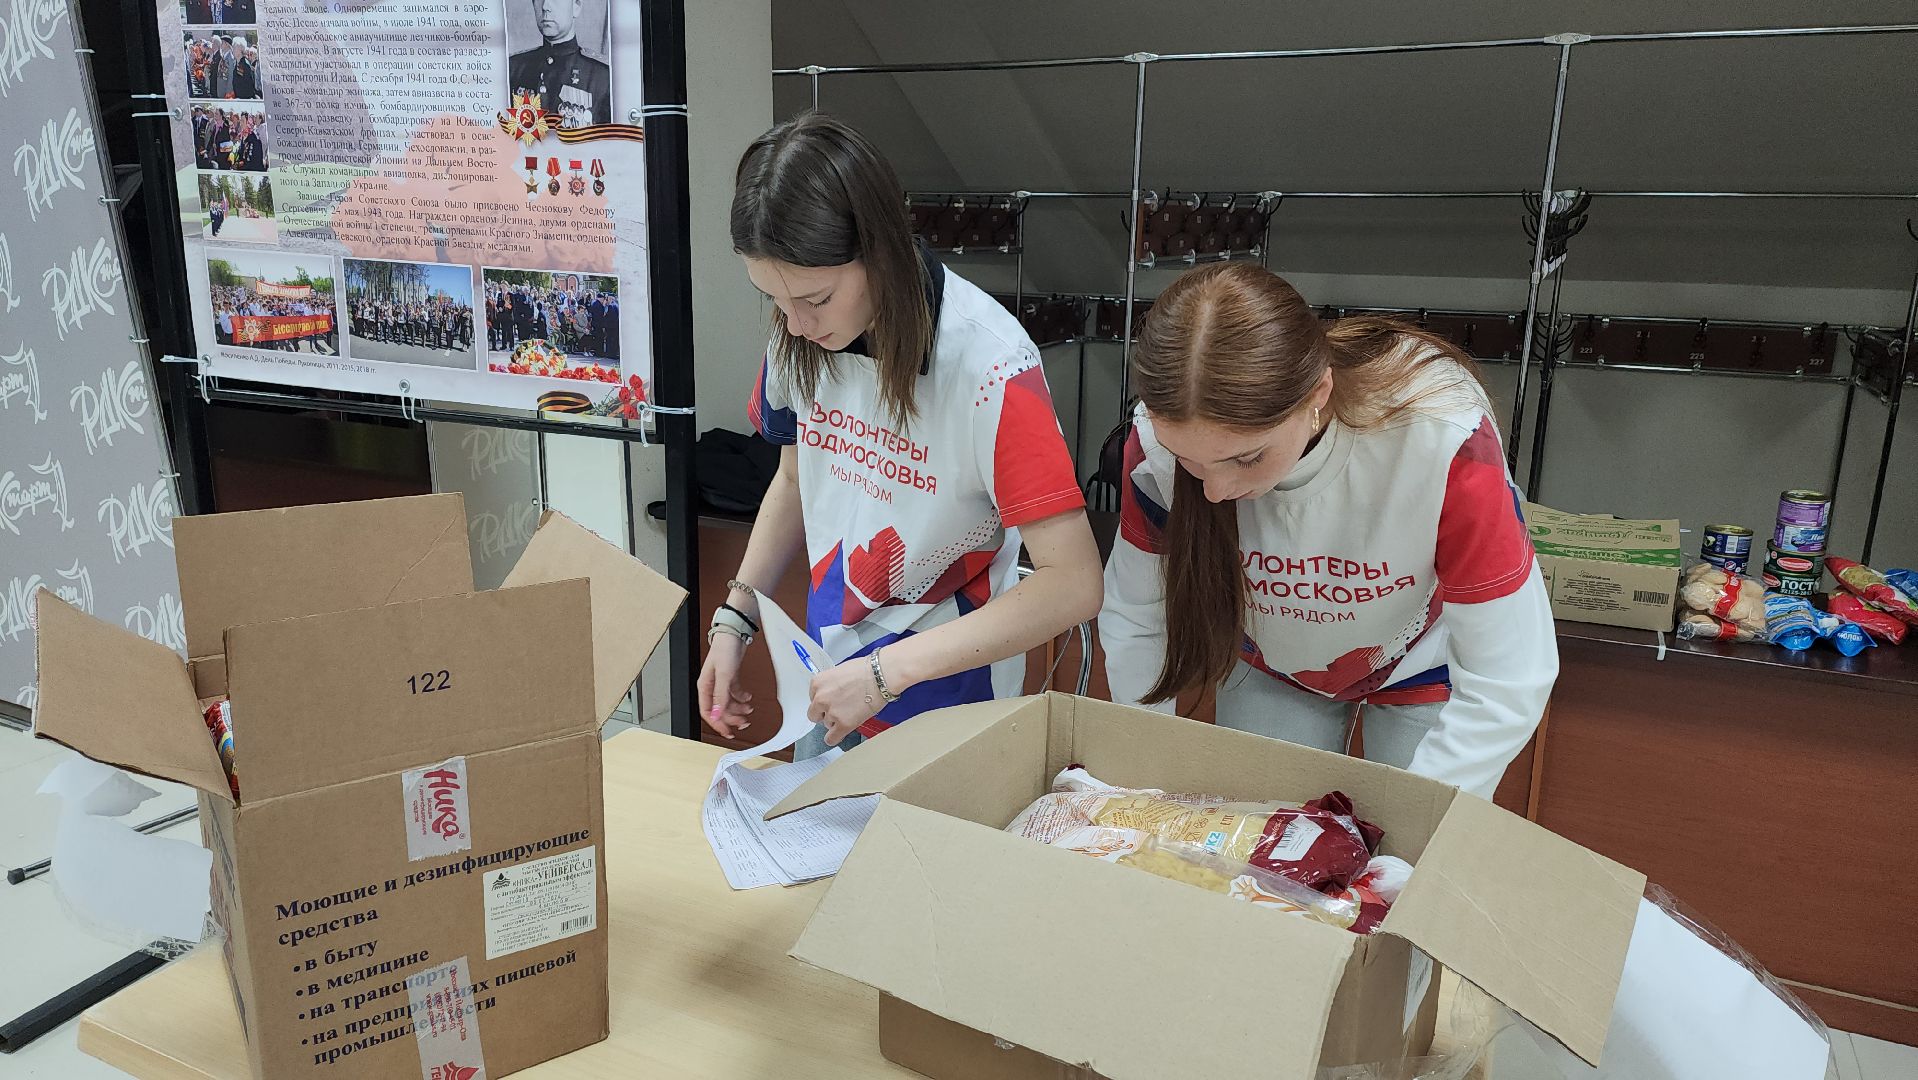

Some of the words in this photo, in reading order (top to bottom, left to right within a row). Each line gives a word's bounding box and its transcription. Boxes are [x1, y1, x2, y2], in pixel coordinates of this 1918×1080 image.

[263, 6, 297, 14] тельном
[300, 6, 329, 15] заводе.
[333, 3, 398, 16] Одновременно
[402, 5, 449, 13] занимался
[462, 5, 488, 15] аэро-
[265, 18, 291, 31] клубе.
[320, 20, 349, 28] начала
[350, 18, 381, 29] войны,
[390, 20, 413, 28] июле
[416, 18, 436, 28] 1941
[438, 20, 462, 29] года,
[464, 20, 489, 28] окон-
[349, 34, 408, 44] авиаучилище
[408, 32, 491, 44] летчиков-бомбар-
[331, 48, 363, 58] августе
[365, 46, 386, 56] 1941
[387, 49, 407, 57] года
[268, 62, 312, 72] скадрильи
[313, 62, 361, 72] участвовал
[371, 62, 414, 73] операции
[416, 63, 462, 71] советских
[465, 60, 492, 71] войск
[269, 74, 279, 82] на
[278, 74, 330, 85] территории
[369, 73, 403, 86] декабря
[406, 73, 425, 84] 1941
[427, 76, 447, 85] года
[448, 74, 470, 84] Ф.С.
[471, 74, 493, 84] Чес-
[270, 88, 295, 96] ноков
[302, 88, 344, 99] командир
[385, 90, 409, 98] затем
[411, 90, 456, 98] авиазвена
[464, 91, 493, 99] соста-
[272, 101, 282, 109] ве
[285, 99, 312, 110] 367-го
[314, 102, 340, 110] полка
[471, 103, 494, 116] Осу-
[273, 114, 312, 123] ществлял
[316, 115, 352, 126] разведку
[368, 114, 435, 128] бомбардировку
[440, 118, 451, 126] на
[455, 116, 495, 128] Южном,
[274, 125, 354, 138] Северо-Кавказском
[276, 138, 317, 150] бождении
[318, 139, 356, 151] Польши,
[357, 140, 402, 153] Германии,
[477, 147, 496, 157] раз-
[277, 154, 303, 164] громе
[303, 154, 371, 166] милитаристской
[373, 154, 408, 165] Японии
[411, 158, 422, 166] на
[424, 156, 464, 167] Дальнем
[466, 157, 498, 168] Восто-
[279, 179, 298, 187] ного
[299, 180, 310, 188] на
[292, 164, 326, 177] Служил
[328, 168, 380, 179] командиром
[431, 172, 498, 183] дислоцирован-
[296, 190, 325, 202] Звание
[327, 192, 353, 205] Героя
[357, 193, 406, 205] Советского
[410, 196, 439, 207] Союза
[444, 197, 467, 208] было
[472, 201, 520, 212] присвоено
[524, 201, 573, 216] Чеснокову
[579, 204, 615, 218] Федору
[330, 205, 341, 216] 24
[344, 209, 359, 217] мая
[362, 207, 382, 218] 1943
[384, 211, 405, 220] года.
[408, 209, 457, 223] Награжден
[459, 214, 496, 225] орденом
[538, 218, 567, 229] двумя
[570, 220, 616, 230] орденами
[282, 215, 344, 228] Отечественной
[345, 219, 373, 230] войны
[380, 223, 417, 234] степени,
[444, 227, 486, 237] орденами
[488, 226, 531, 239] Красного
[532, 229, 575, 242] Знамени,
[576, 234, 617, 244] орденом
[284, 228, 332, 243] Александра
[333, 231, 374, 244] Невского,
[375, 236, 411, 246] орденом
[413, 236, 450, 249] Красной
[810, 402, 929, 464] ВОЛОНТЕРЫ
[830, 463, 851, 484] МЫ
[853, 473, 893, 504] РЯДОМ
[1241, 550, 1389, 581] ЛОНТЕРЫ
[1249, 575, 1416, 604] МОСКОВЬЯ
[1781, 579, 1815, 591] ГОСТ
[1245, 602, 1275, 616] МЫ
[1281, 605, 1356, 624] РЯДОМ
[406, 669, 451, 695] 122
[423, 768, 461, 841] Ника
[274, 884, 378, 921] Моющие
[384, 878, 398, 893] и
[403, 828, 590, 890] дезинфицирующие
[278, 909, 378, 947] средства
[305, 958, 317, 971] в
[324, 940, 378, 965] быту
[308, 983, 320, 996] в
[327, 950, 430, 990] медицине
[313, 1028, 338, 1045] на
[495, 950, 577, 987] пищевой
[310, 1003, 336, 1020] на
